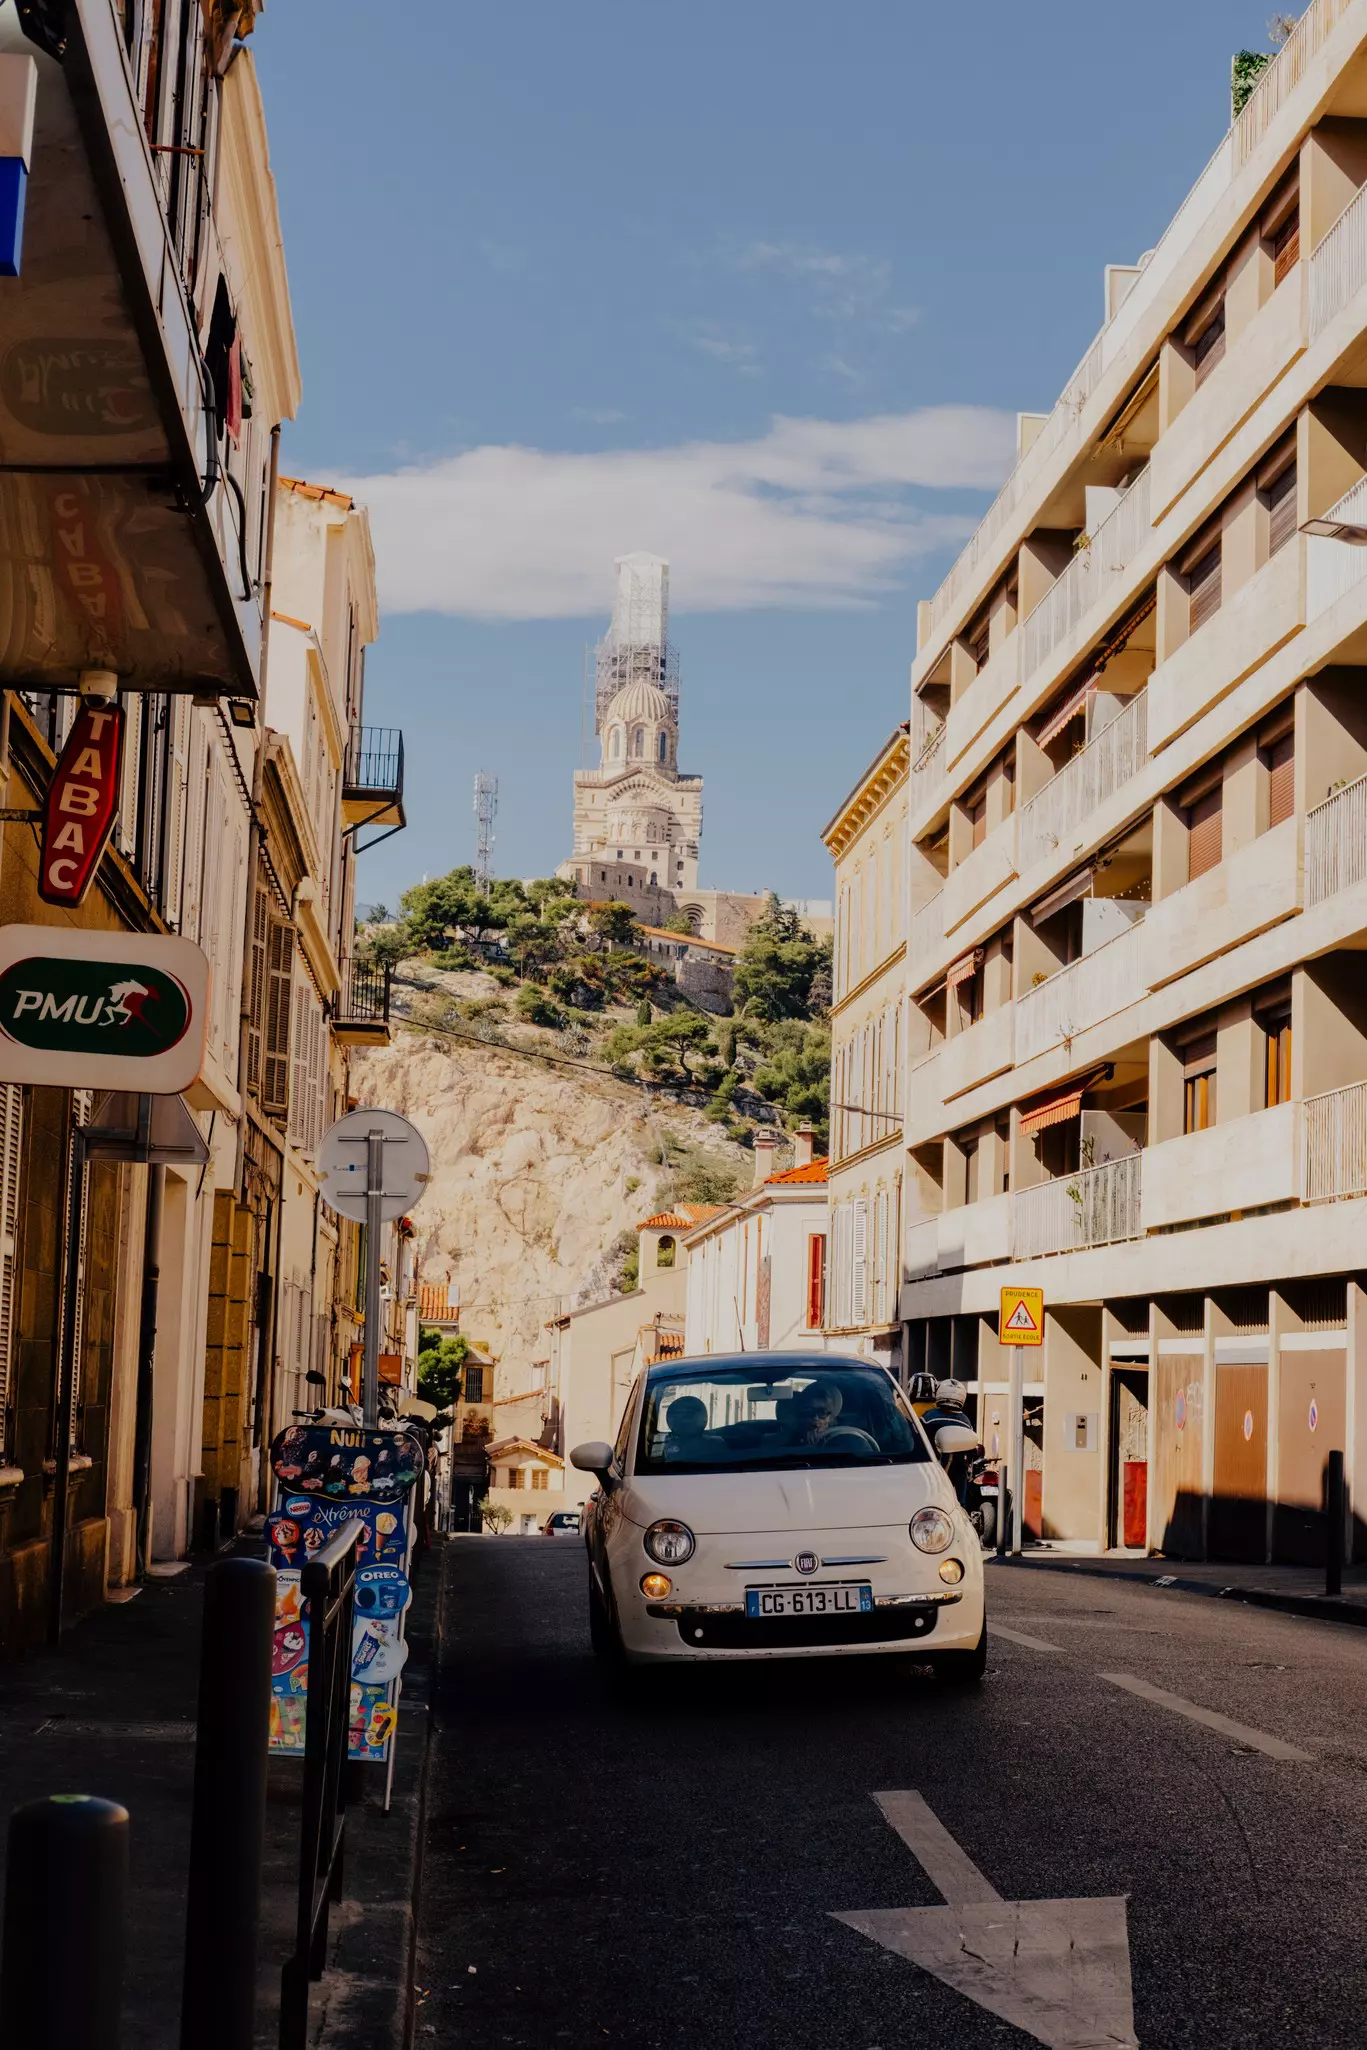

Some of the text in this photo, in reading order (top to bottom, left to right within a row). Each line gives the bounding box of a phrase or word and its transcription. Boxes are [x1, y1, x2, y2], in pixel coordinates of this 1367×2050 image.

[48, 710, 112, 889] TABAC
[12, 989, 105, 1026] PMU
[1005, 1290, 1039, 1298] PRUDENCE
[330, 1429, 367, 1448] Nuii
[800, 1557, 813, 1569] FIAT
[360, 1571, 399, 1582] OREO
[761, 1591, 857, 1614] CG-613-LL
[861, 1600, 872, 1611] 13
